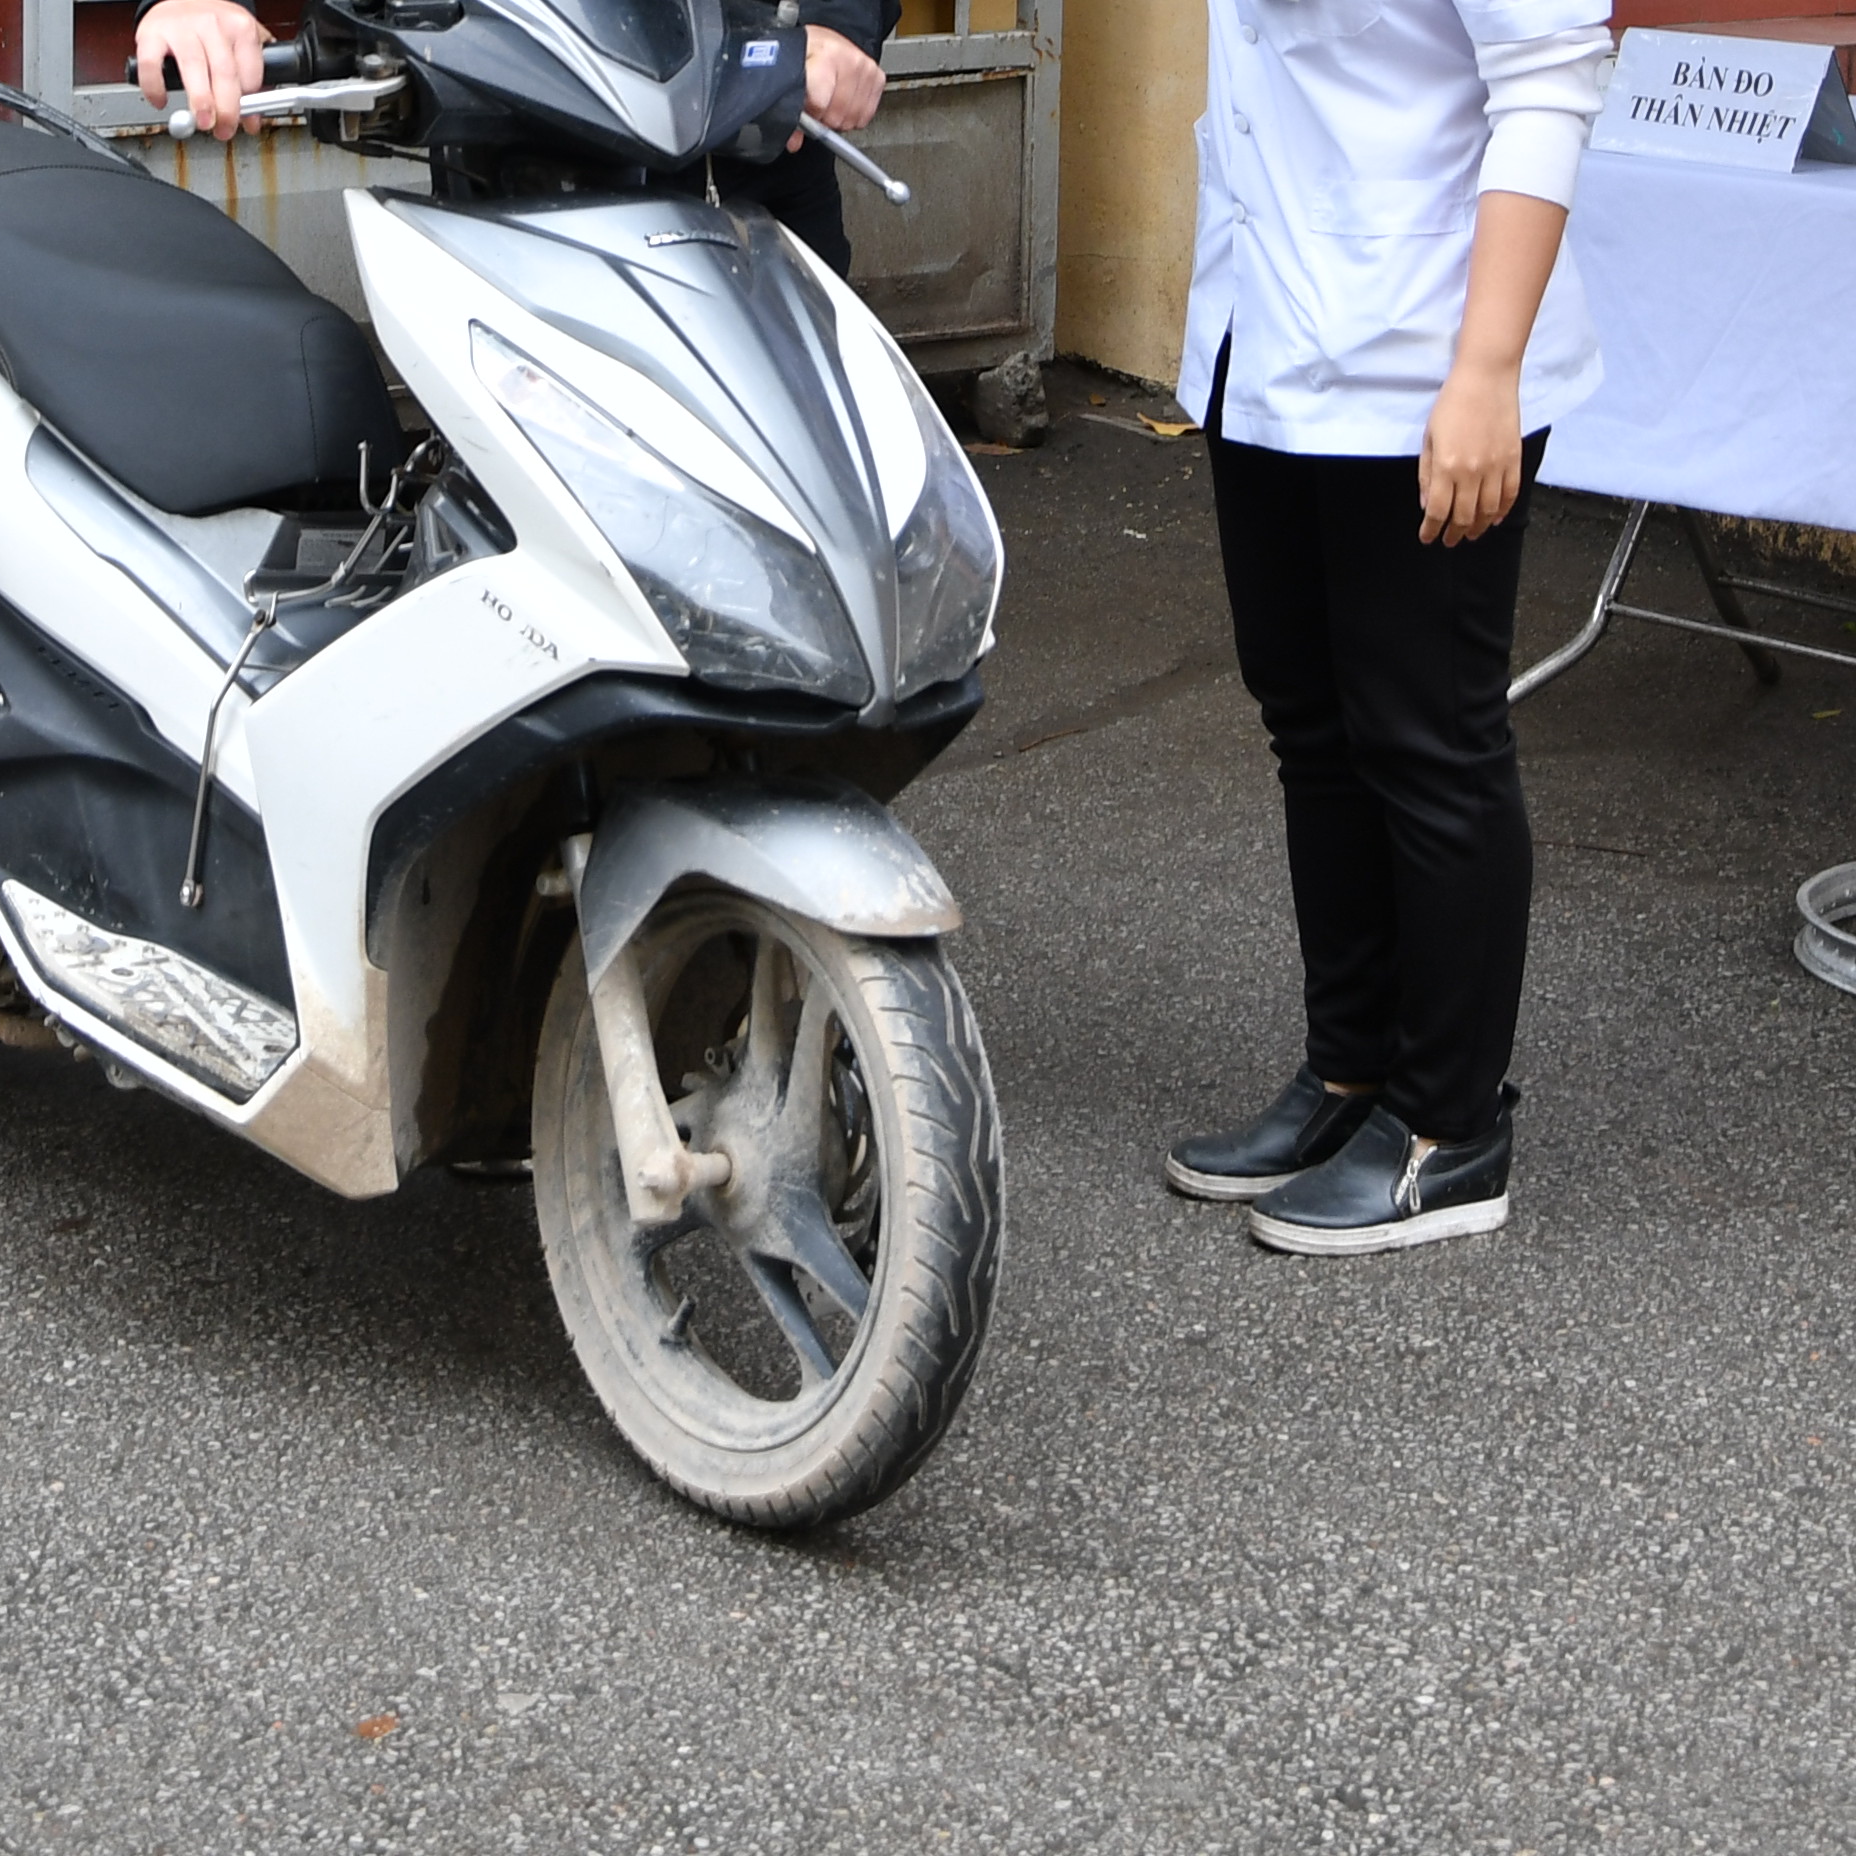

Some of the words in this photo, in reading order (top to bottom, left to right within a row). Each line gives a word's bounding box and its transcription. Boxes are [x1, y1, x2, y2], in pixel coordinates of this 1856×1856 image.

[1733, 69, 1774, 97] ĐO
[1630, 94, 1705, 129] THÂN
[1706, 106, 1797, 144] NHIỆT
